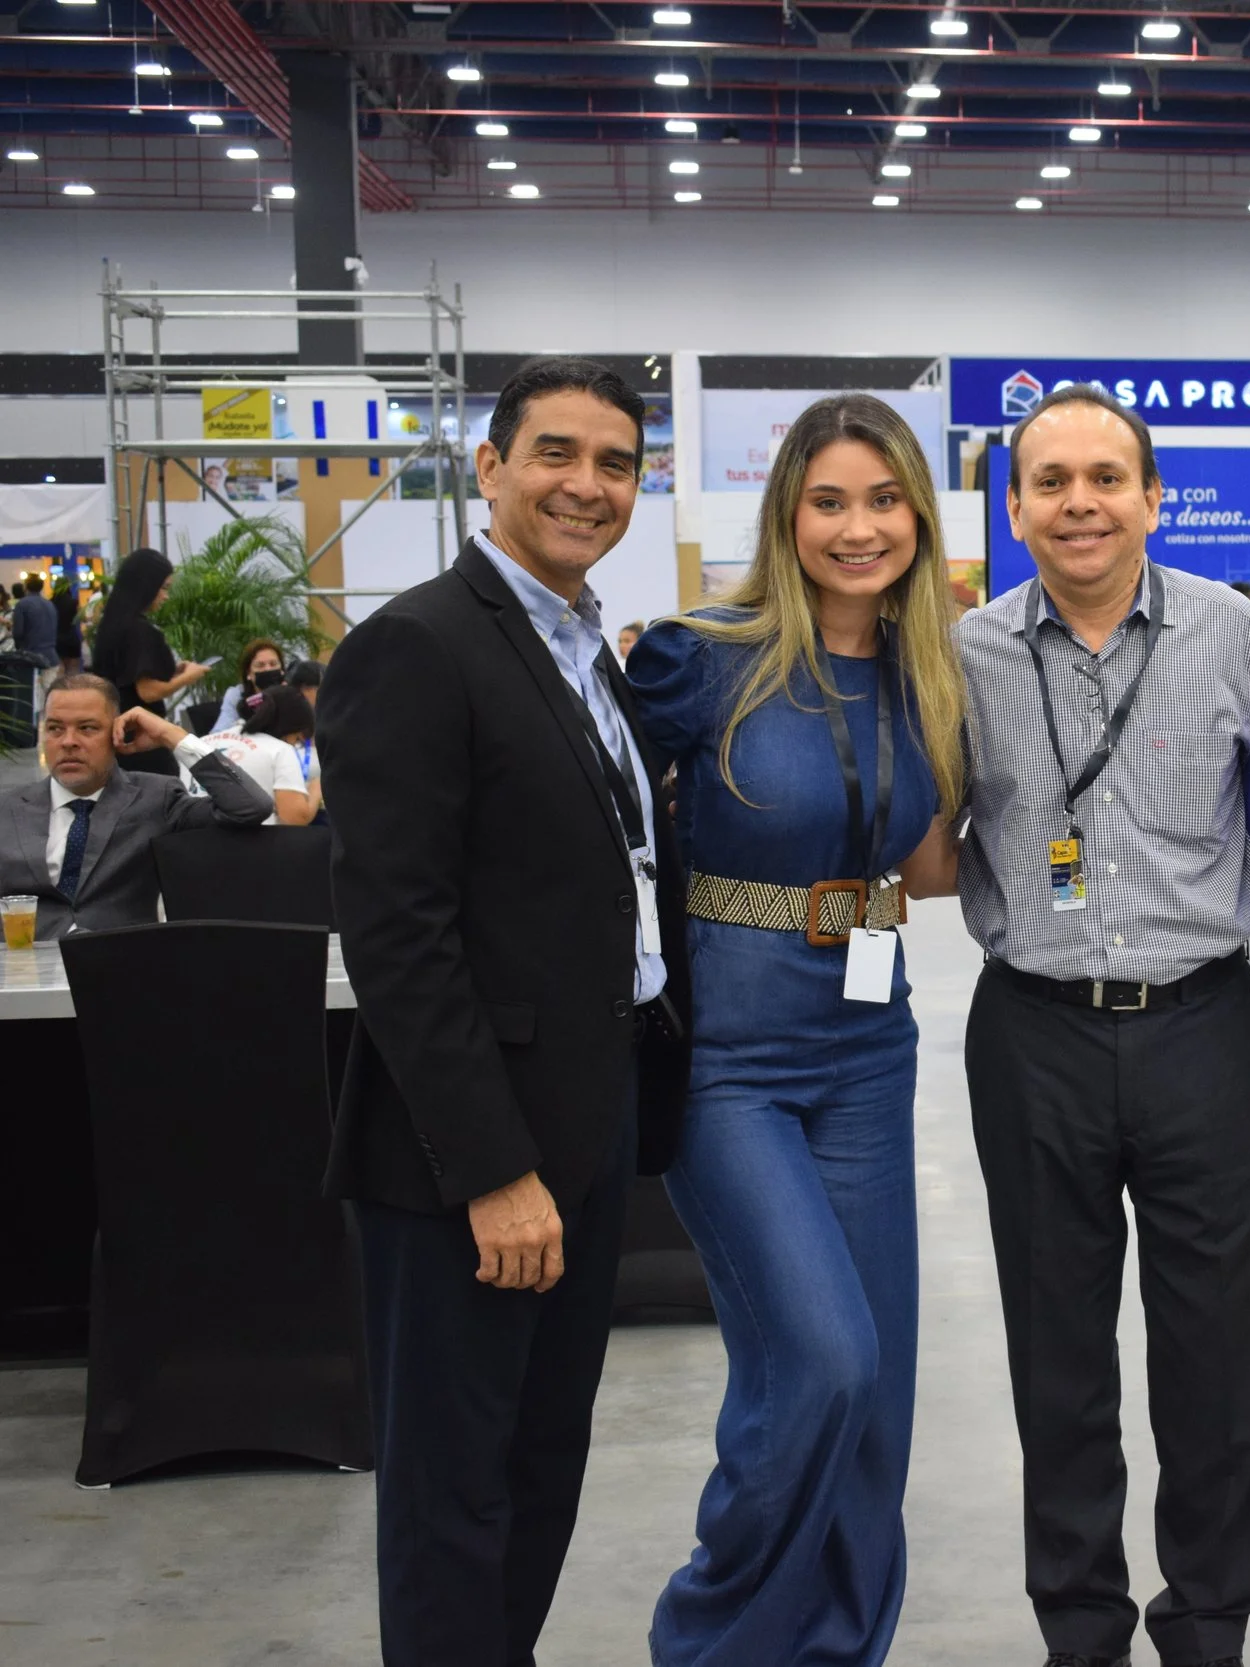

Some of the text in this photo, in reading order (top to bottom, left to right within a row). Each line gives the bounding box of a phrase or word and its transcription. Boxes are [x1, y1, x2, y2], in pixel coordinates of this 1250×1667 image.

[1053, 379, 1170, 408] SA
[1182, 487, 1218, 503] con
[1197, 534, 1216, 545] con
